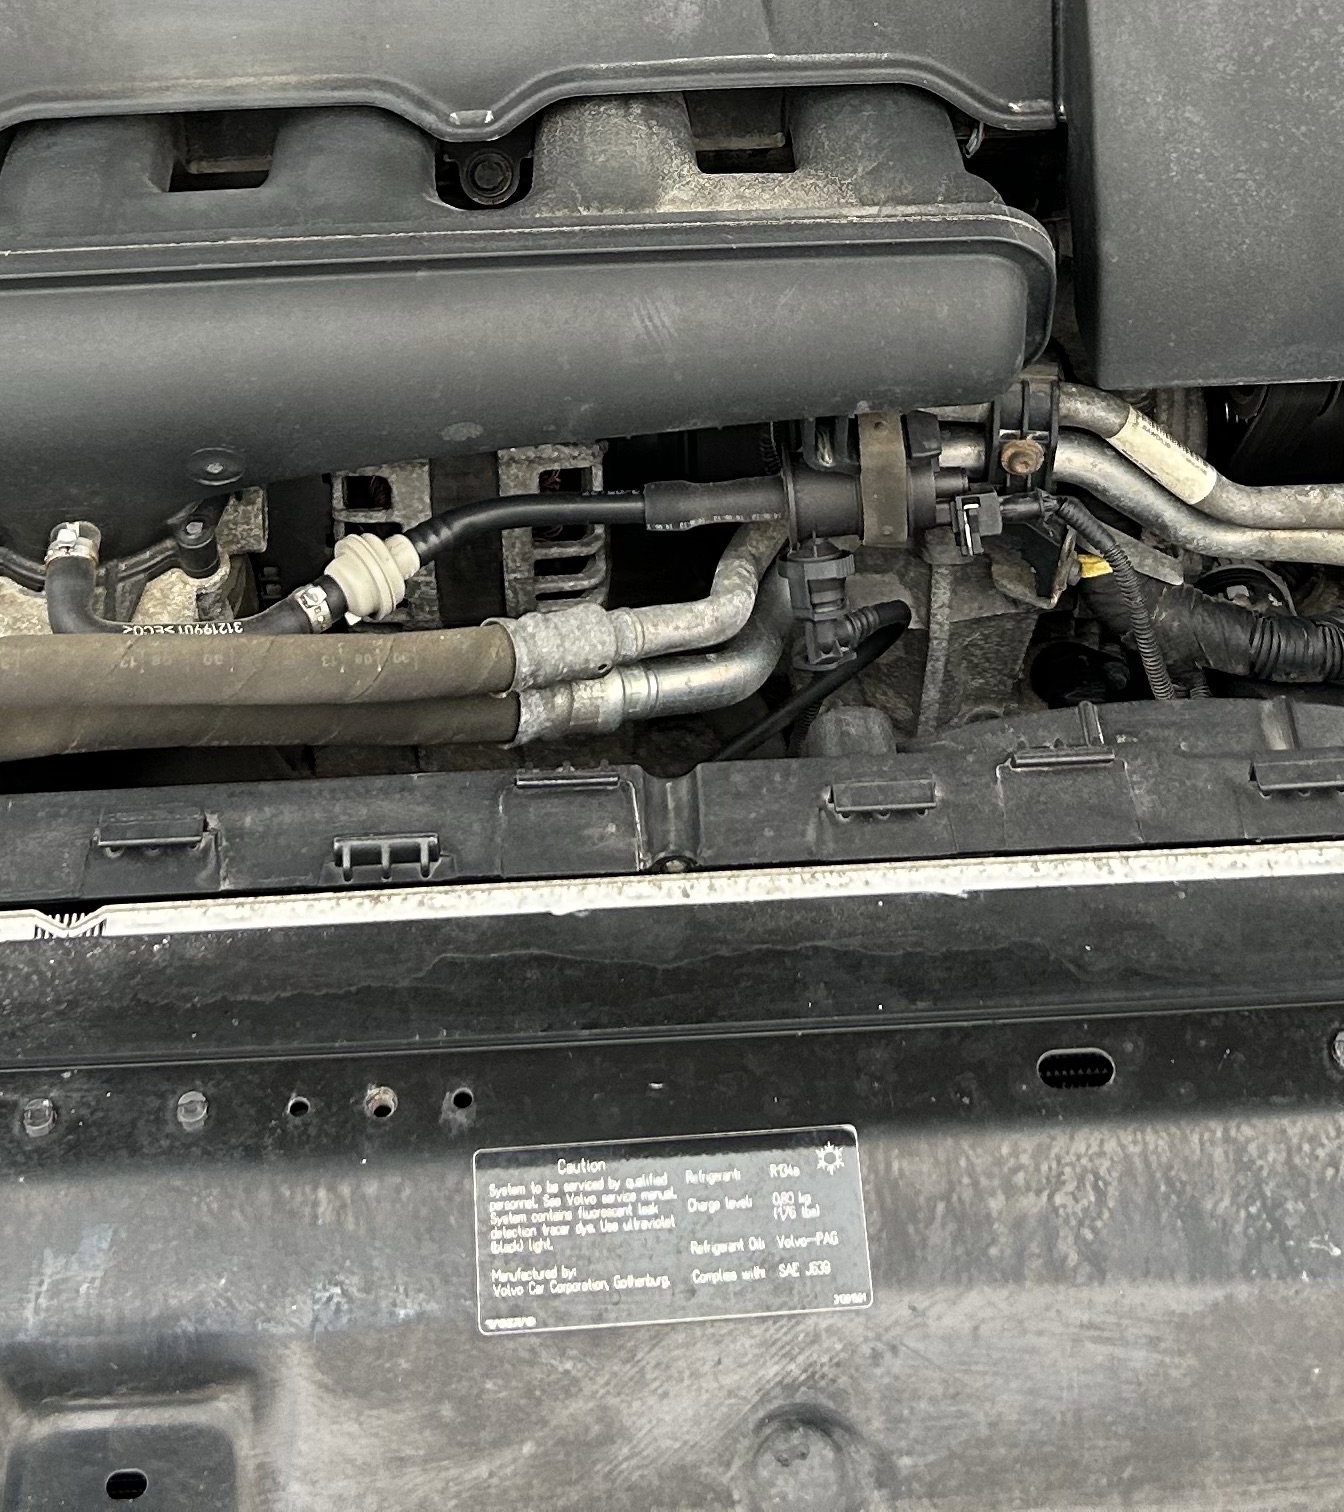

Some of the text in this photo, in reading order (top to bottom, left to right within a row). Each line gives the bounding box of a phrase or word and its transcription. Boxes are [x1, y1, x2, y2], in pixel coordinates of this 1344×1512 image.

[557, 1157, 606, 1175] Caution
[488, 1172, 668, 1199] System to be serviced by qualified
[489, 1196, 538, 1213] personnel.
[543, 1194, 562, 1208] See
[565, 1193, 597, 1207] Volvo
[601, 1190, 636, 1204] service
[687, 1197, 721, 1214] Charge
[798, 1191, 812, 1206] kg
[490, 1201, 659, 1228] System contains fluorescent leak
[490, 1226, 537, 1240] detection
[542, 1223, 570, 1237] tracer
[600, 1220, 619, 1233] Use
[622, 1215, 676, 1231] ultraviolet
[490, 1239, 524, 1255] (black)
[690, 1238, 745, 1256] Refrigerant
[491, 1264, 558, 1282] Manufactured
[692, 1268, 737, 1284] Complies
[778, 1259, 831, 1278] SAE J639
[492, 1283, 524, 1298] Volvo
[528, 1280, 545, 1296] Car
